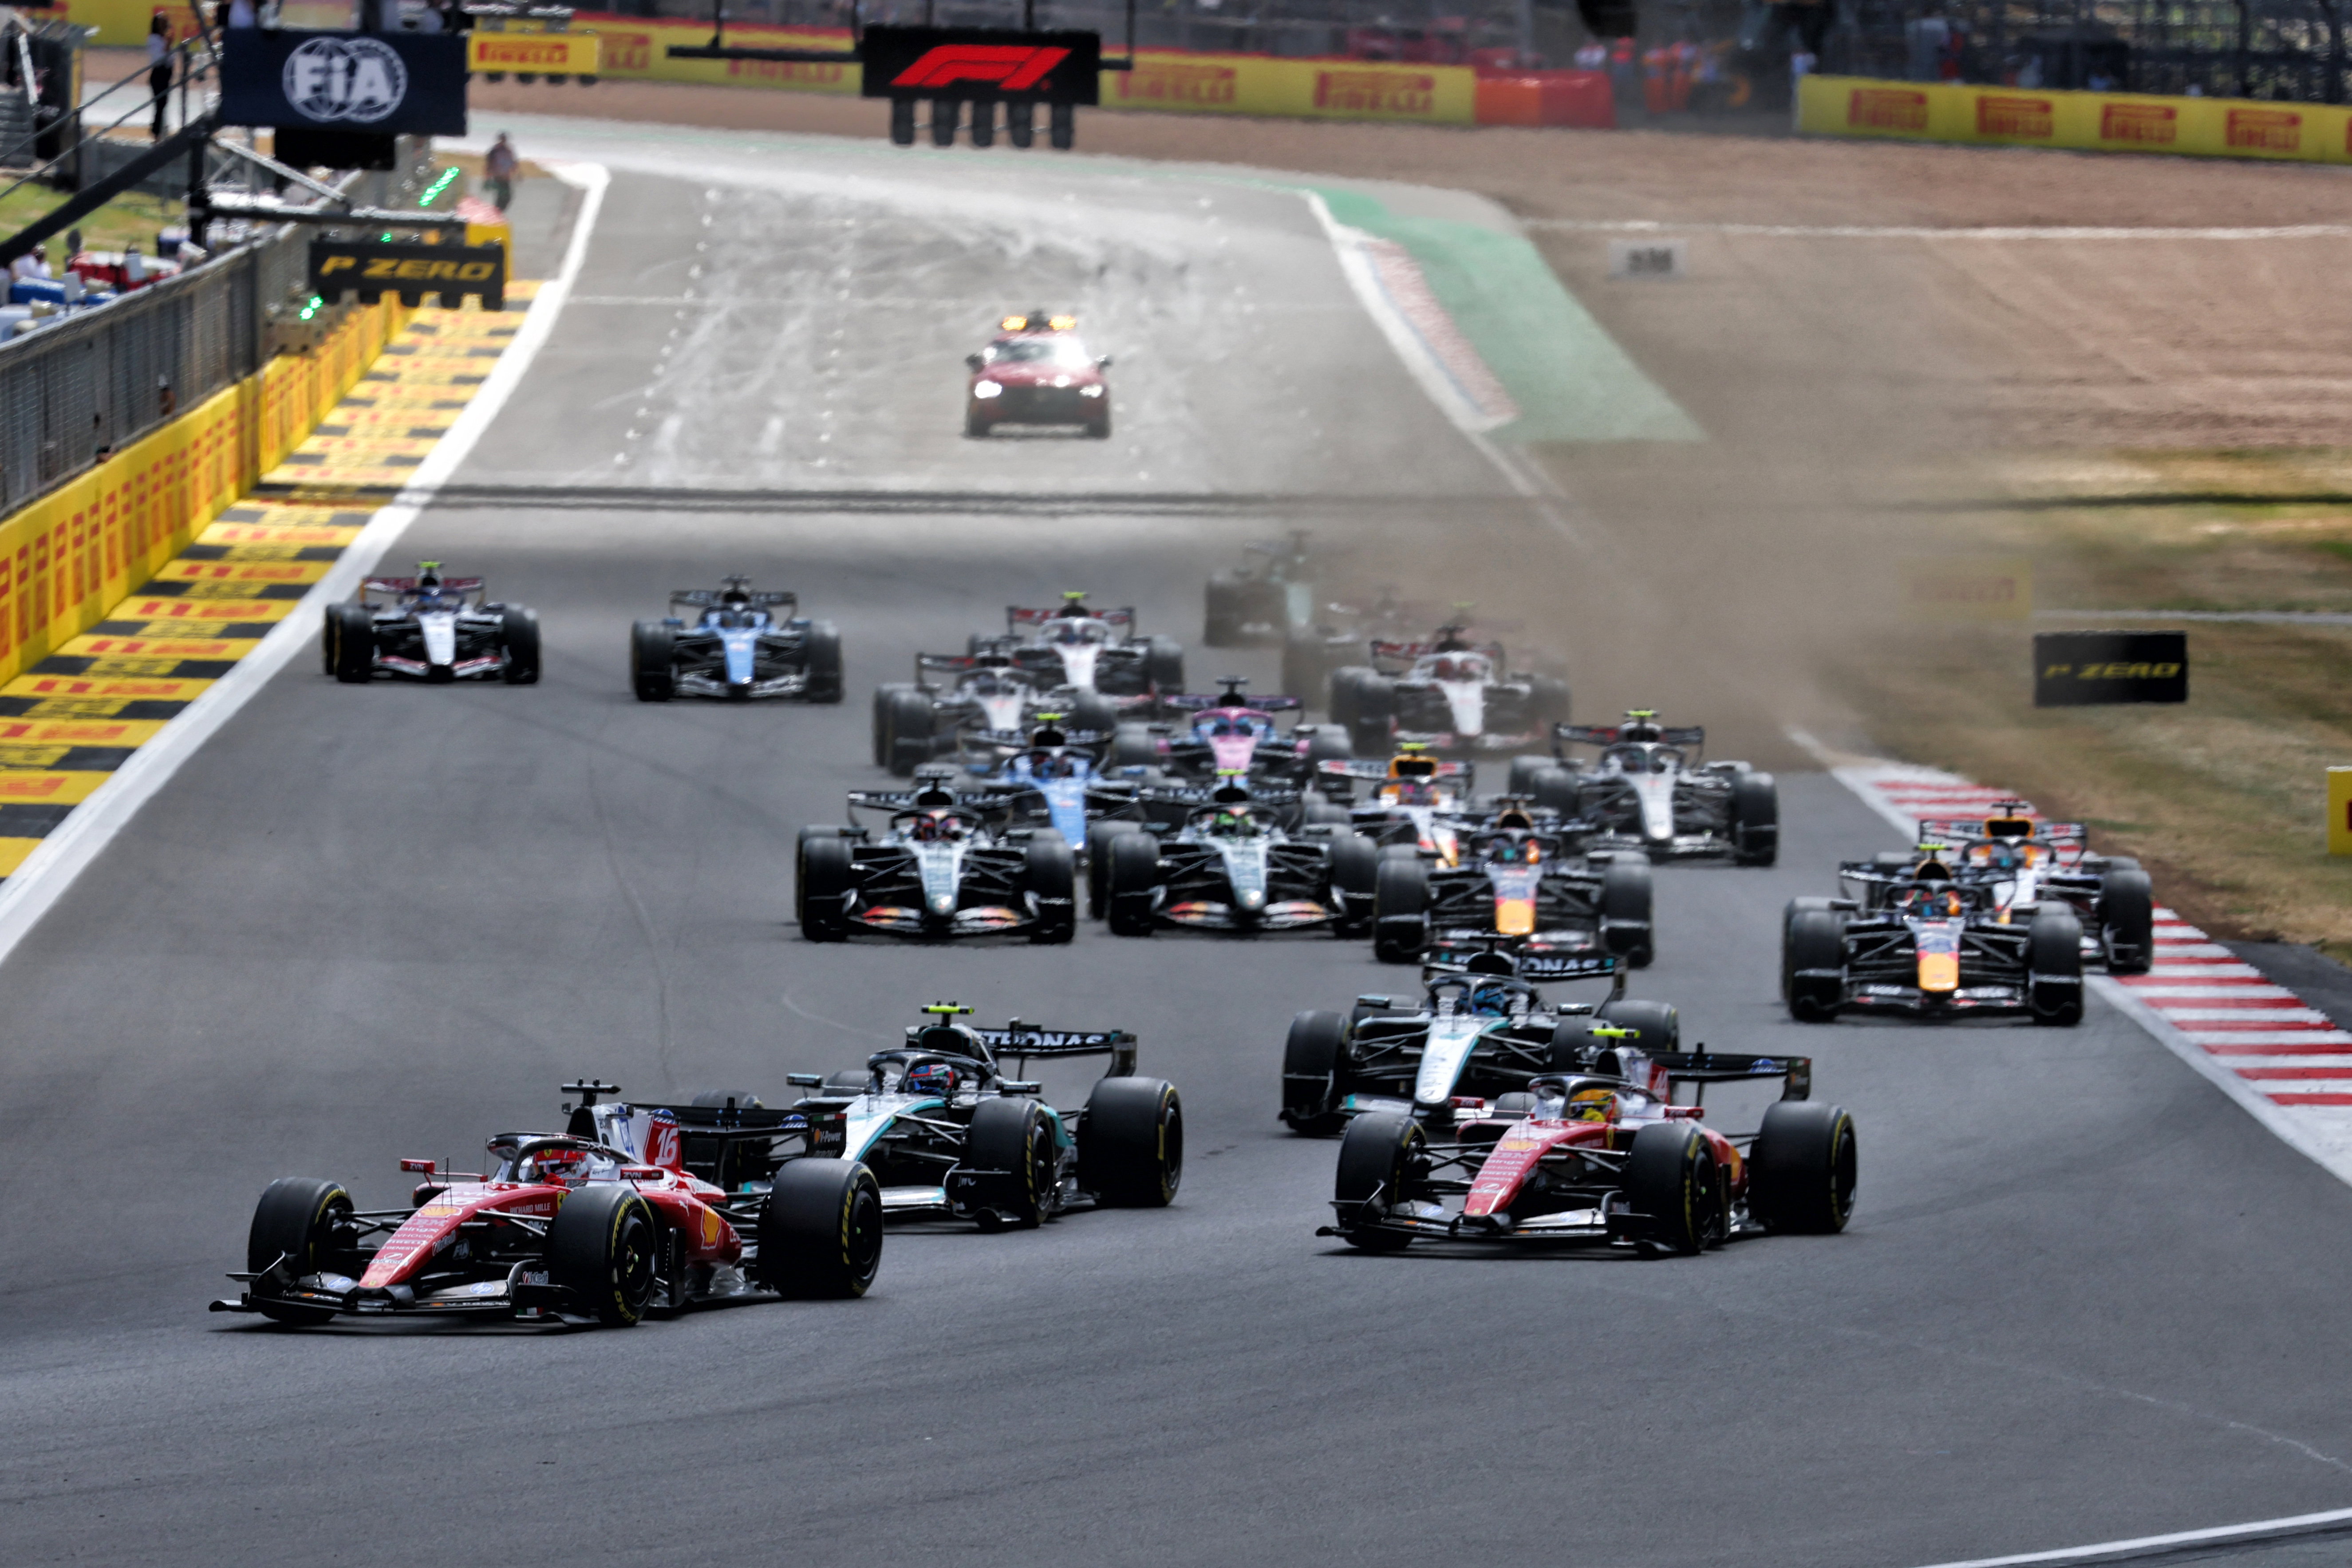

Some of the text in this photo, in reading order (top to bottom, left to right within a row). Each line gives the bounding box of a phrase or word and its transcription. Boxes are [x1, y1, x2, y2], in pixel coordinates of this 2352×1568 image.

[478, 42, 568, 64] PIRELLI
[889, 44, 1073, 89] F1
[319, 256, 496, 280] P ZERO
[2043, 662, 2181, 680] P ZERO
[654, 1128, 679, 1166] 16
[409, 1162, 425, 1171] ZVN
[509, 1202, 551, 1214] RICHARD MILLE
